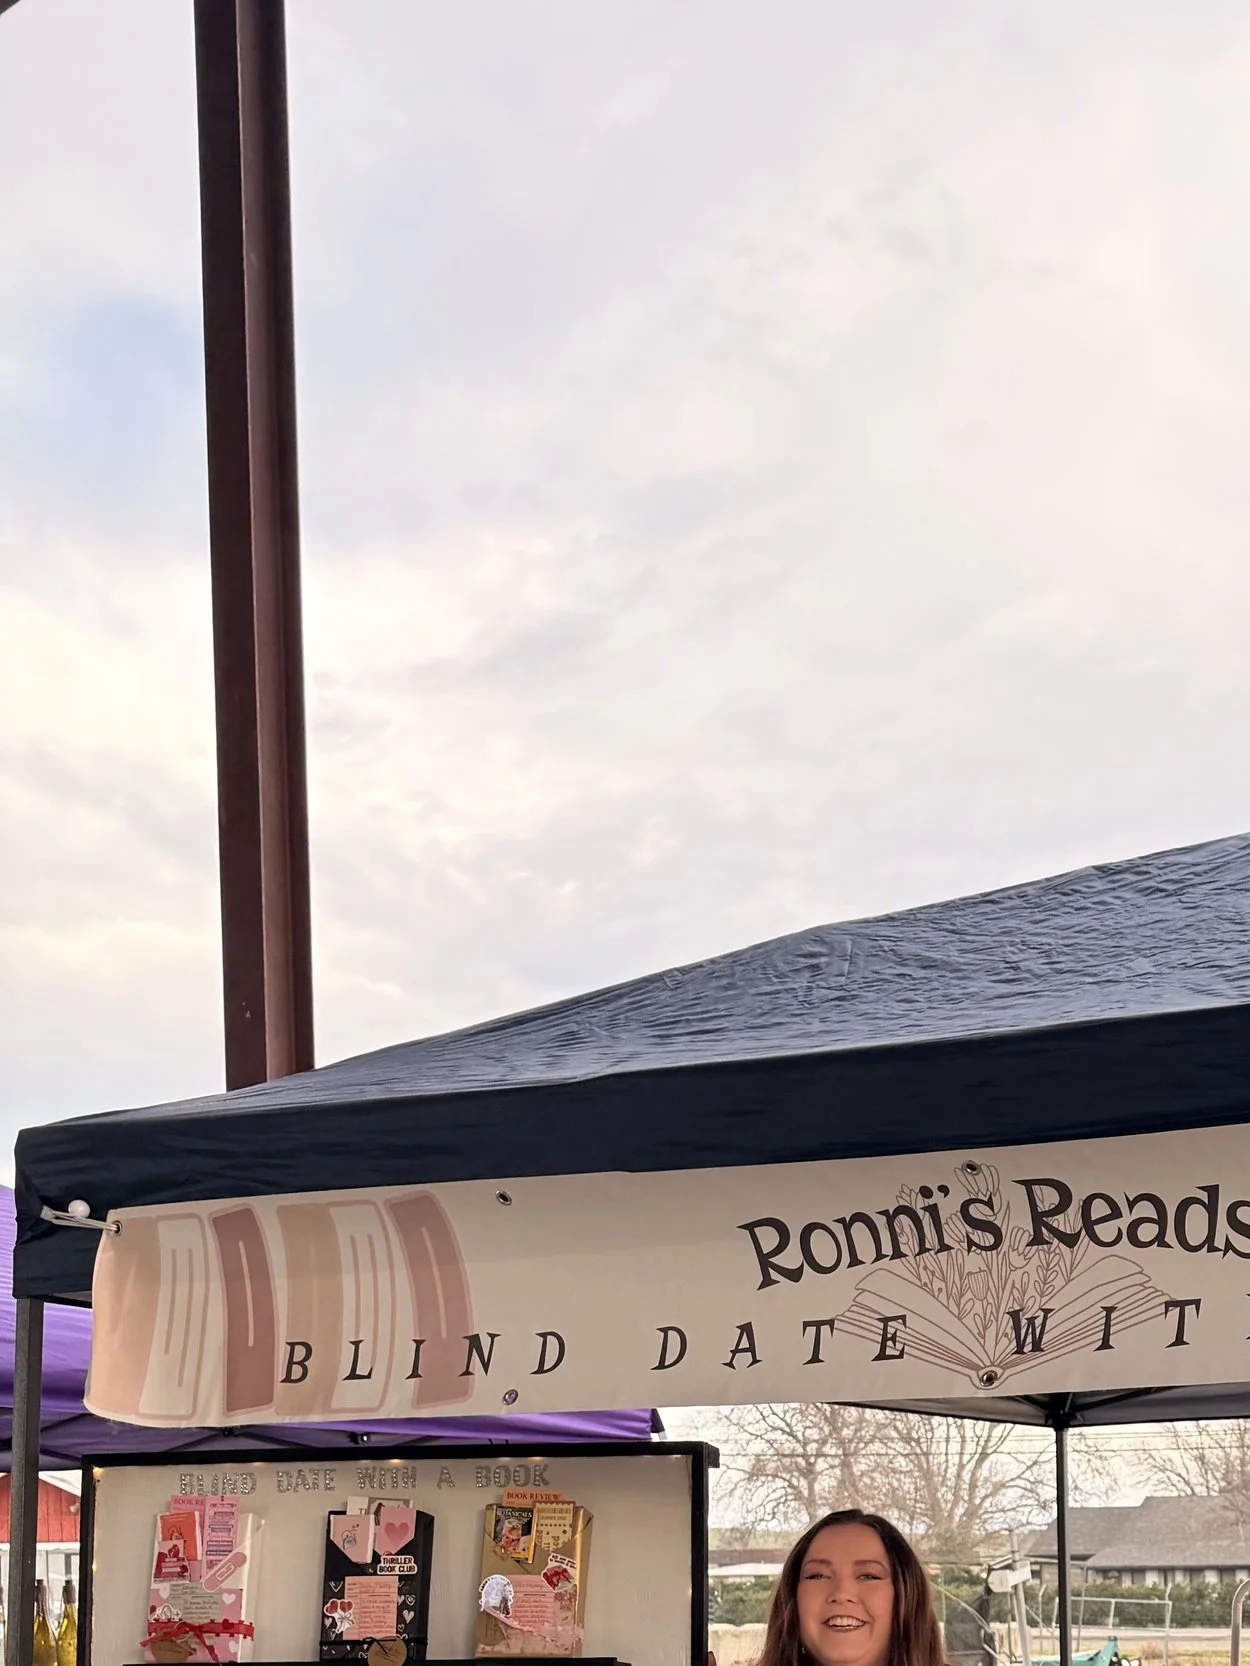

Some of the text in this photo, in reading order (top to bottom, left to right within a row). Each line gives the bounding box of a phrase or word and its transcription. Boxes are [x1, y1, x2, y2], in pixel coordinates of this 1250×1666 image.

[737, 1184, 1001, 1290] Ronni's
[280, 1331, 567, 1384] BLIND
[651, 1313, 909, 1371] DATE
[179, 1464, 551, 1496] BLIND DATE WITH A BOOK
[507, 1491, 561, 1501] BOOK REVIEW
[382, 1557, 413, 1565] THRILLER
